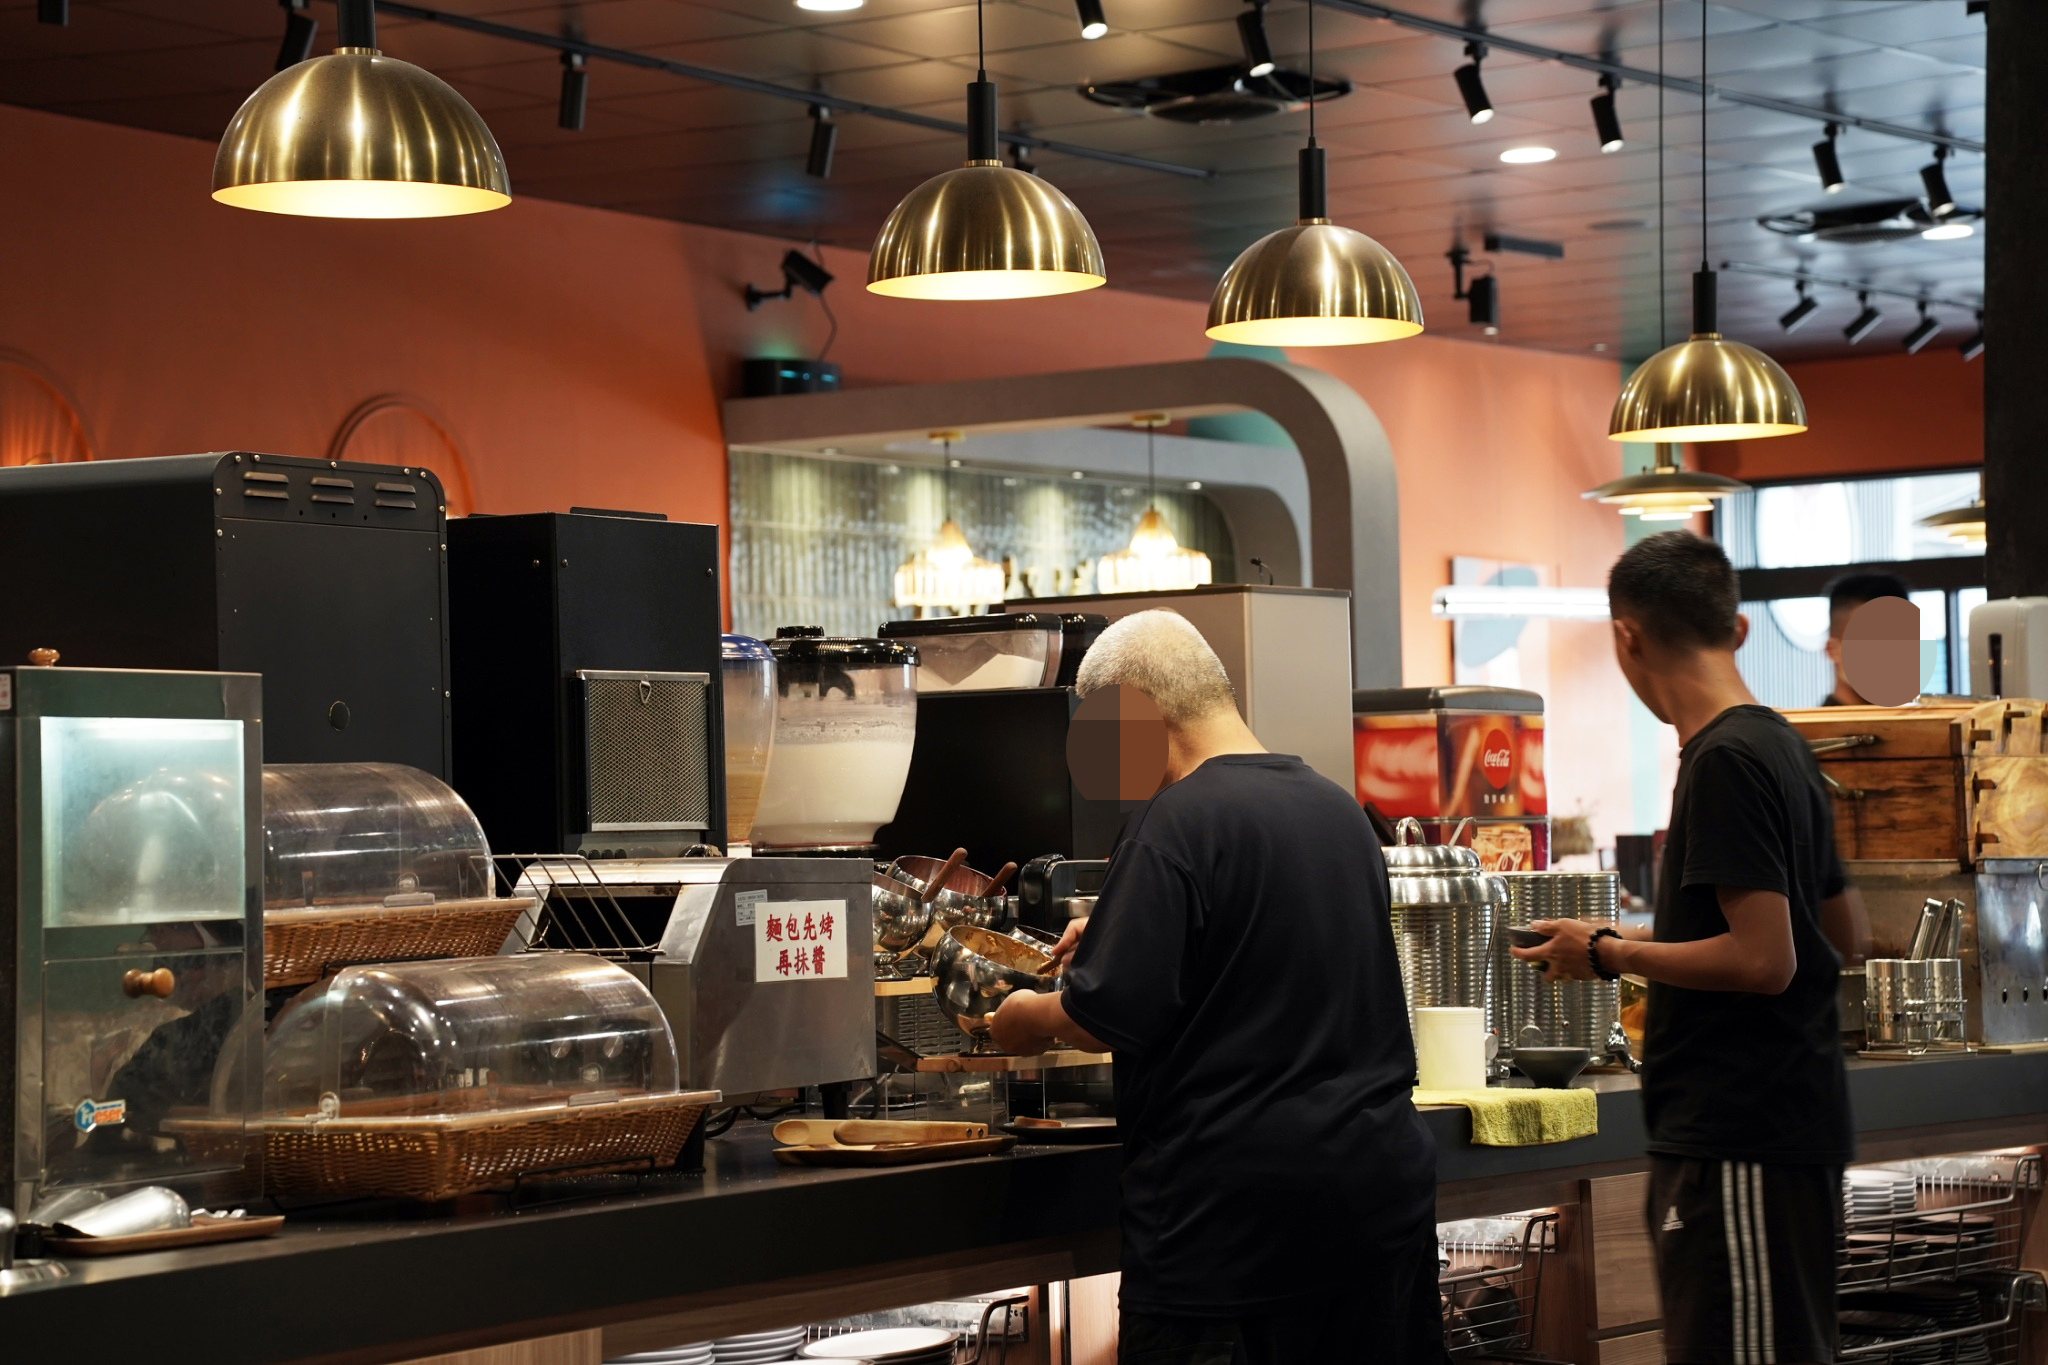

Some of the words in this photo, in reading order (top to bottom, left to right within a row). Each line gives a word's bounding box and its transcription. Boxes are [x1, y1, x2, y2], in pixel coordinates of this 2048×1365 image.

[766, 911, 834, 942] 麵包先烤
[776, 945, 825, 976] 再抹醬
